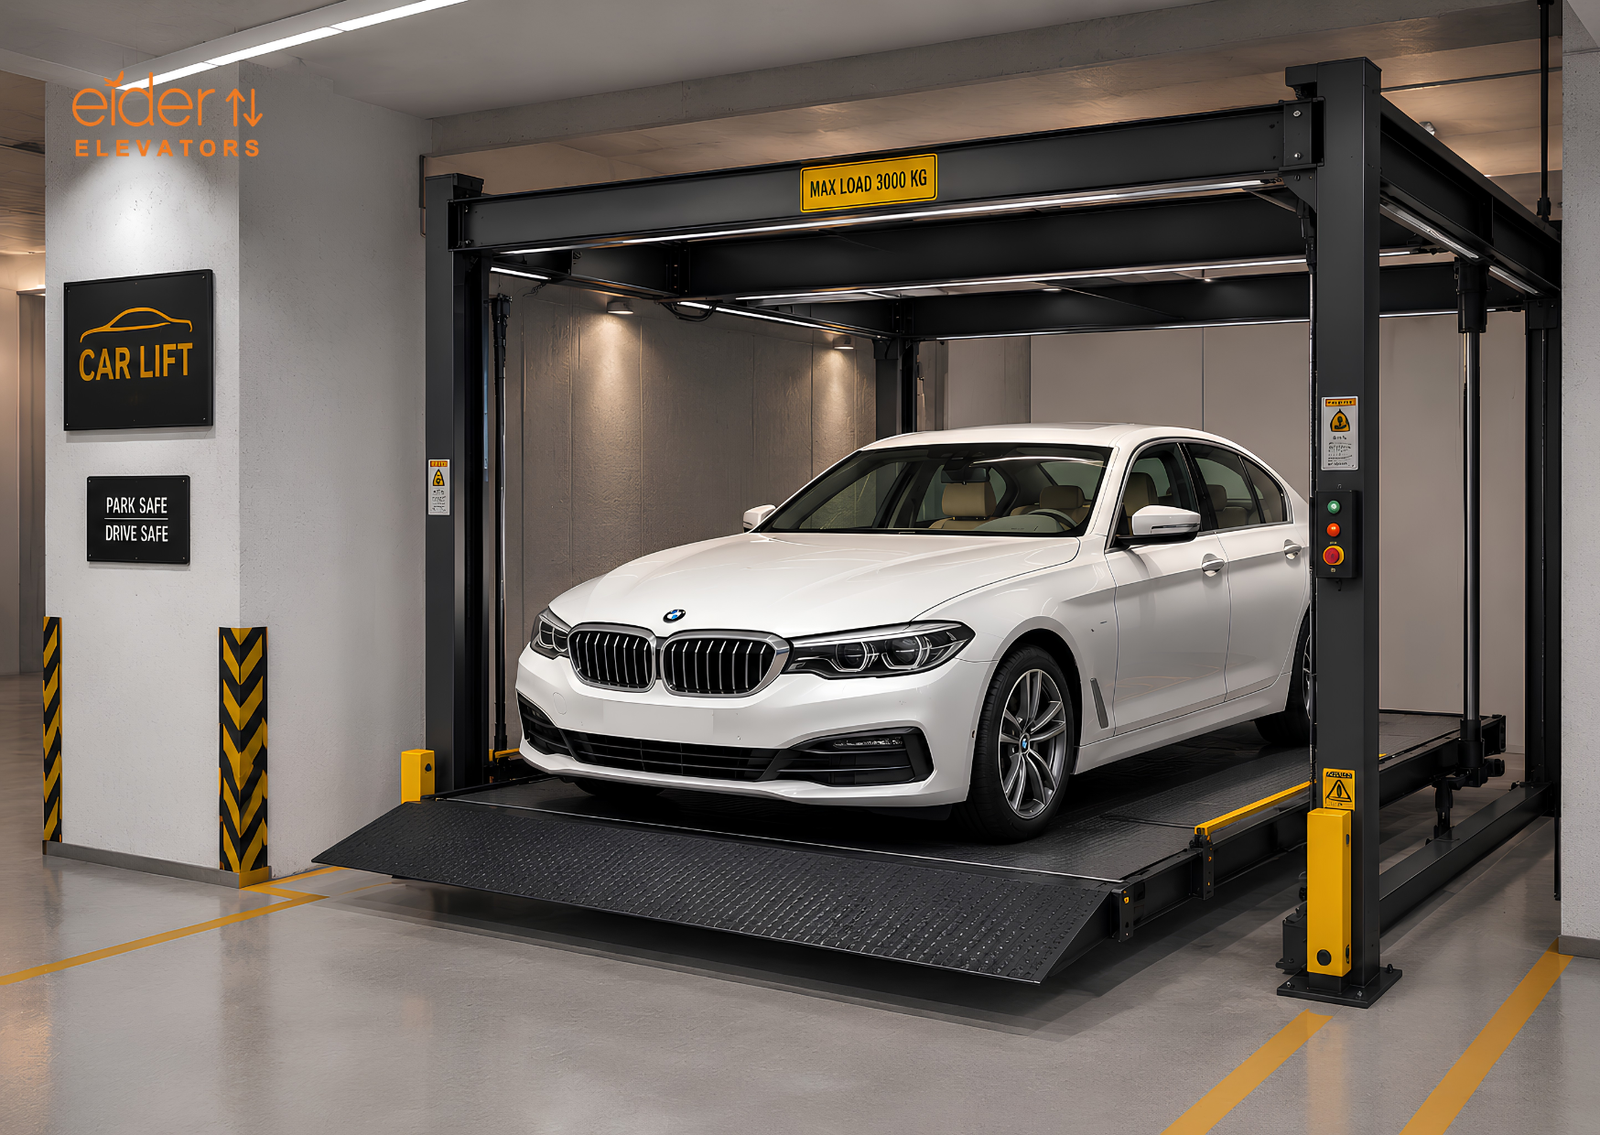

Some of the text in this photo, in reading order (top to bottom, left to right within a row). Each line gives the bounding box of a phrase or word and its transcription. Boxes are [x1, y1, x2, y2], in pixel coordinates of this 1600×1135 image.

[810, 168, 927, 198] MAX LOAD 3000 KG
[78, 342, 193, 382] CAR LIFT
[106, 496, 168, 514] PARK SAFE
[105, 524, 169, 542] DRIVE SAFE
